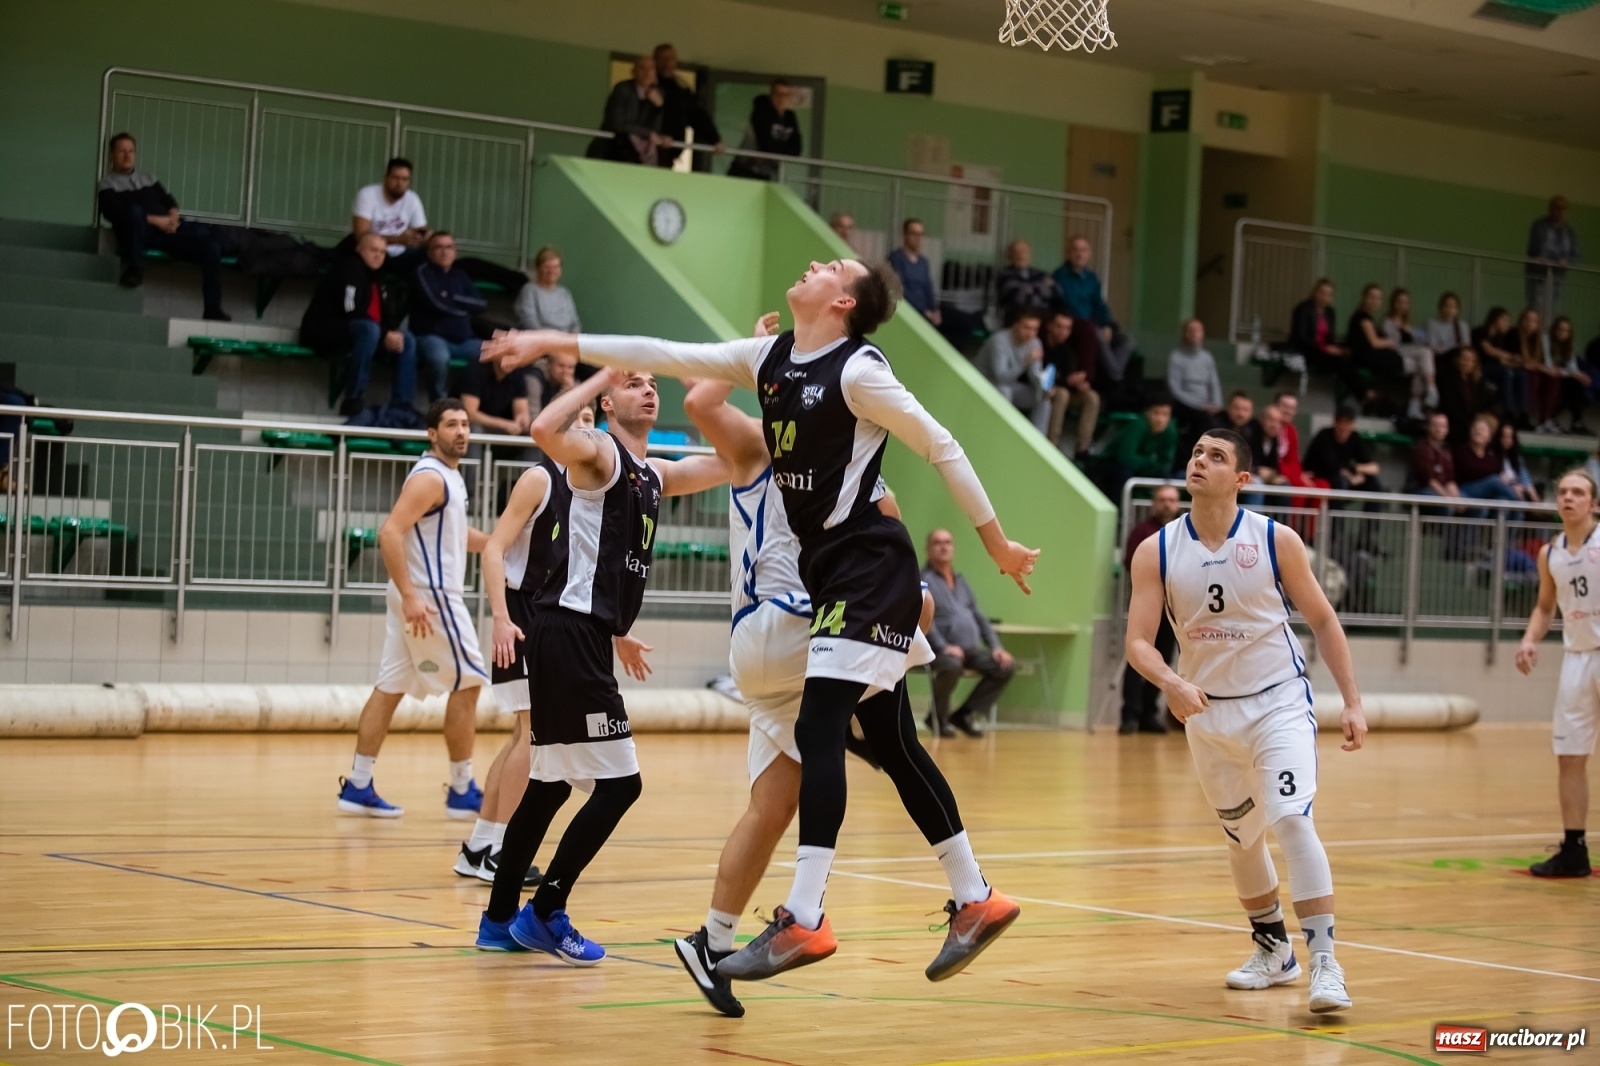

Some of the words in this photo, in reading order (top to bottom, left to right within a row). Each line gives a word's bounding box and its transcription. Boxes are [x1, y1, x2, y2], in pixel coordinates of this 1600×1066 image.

[899, 71, 922, 90] F
[1161, 105, 1182, 128] F
[772, 420, 797, 458] 14
[1569, 575, 1588, 598] 13
[1208, 583, 1225, 614] 3
[1201, 632, 1245, 640] KAMPKA
[1278, 770, 1297, 797] 3
